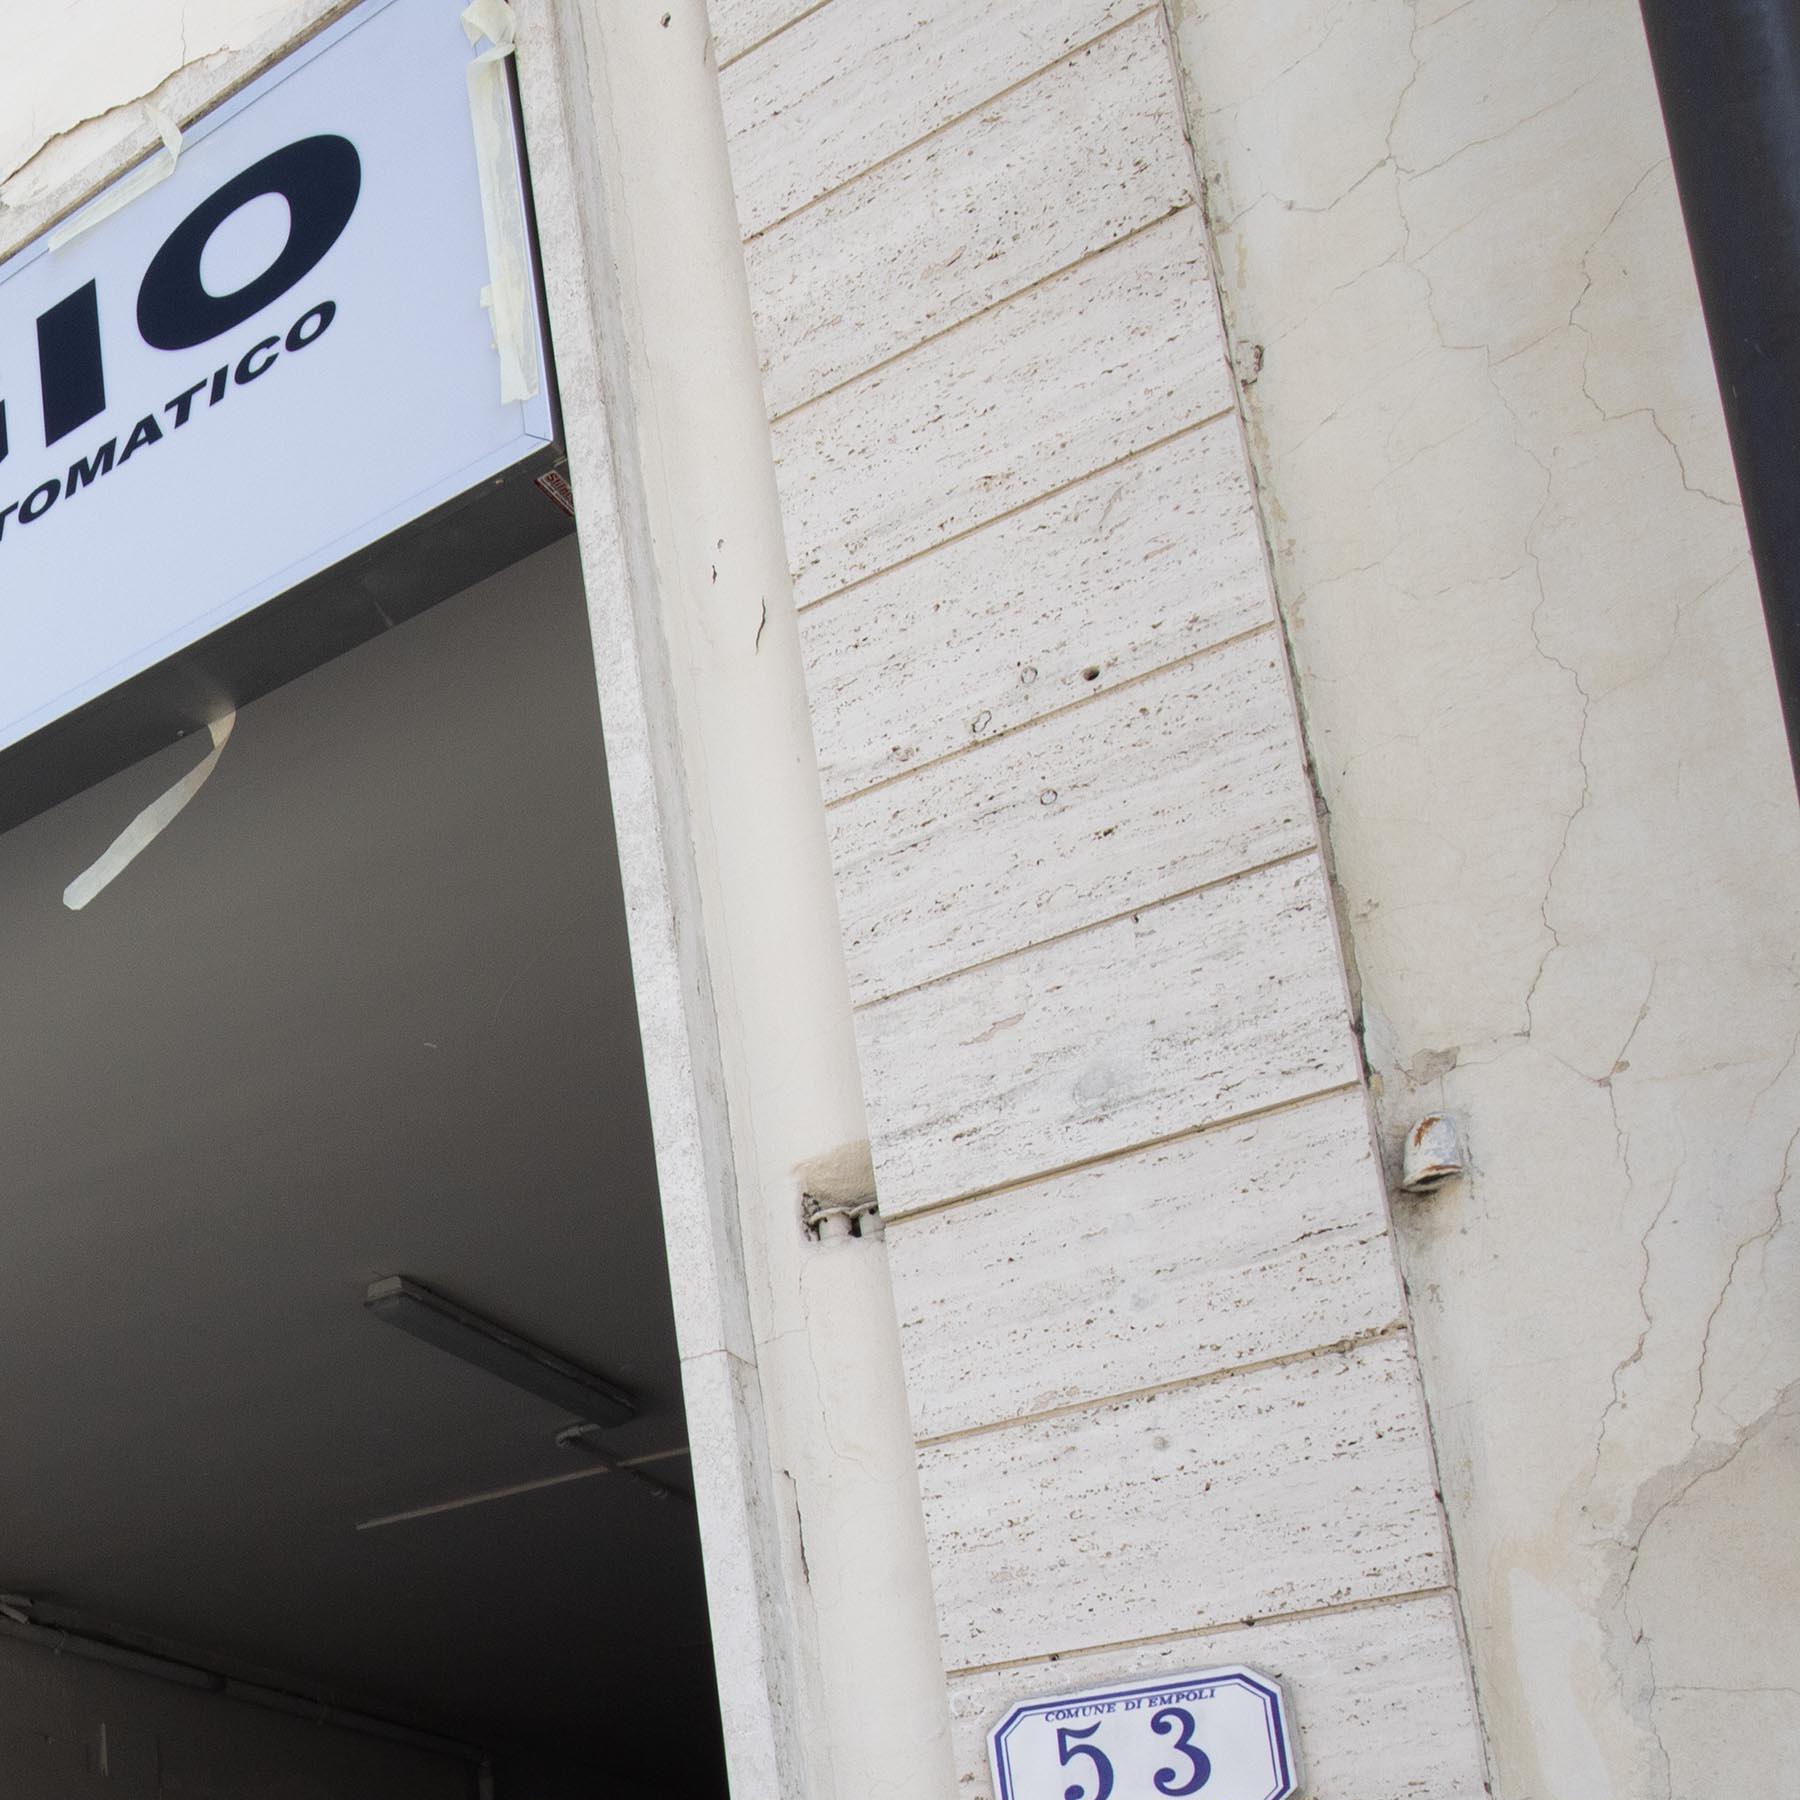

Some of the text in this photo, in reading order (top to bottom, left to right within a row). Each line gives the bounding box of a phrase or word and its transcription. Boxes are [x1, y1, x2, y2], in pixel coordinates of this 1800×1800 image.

[1045, 1688, 1216, 1722] COMUNE DI EMPOLI
